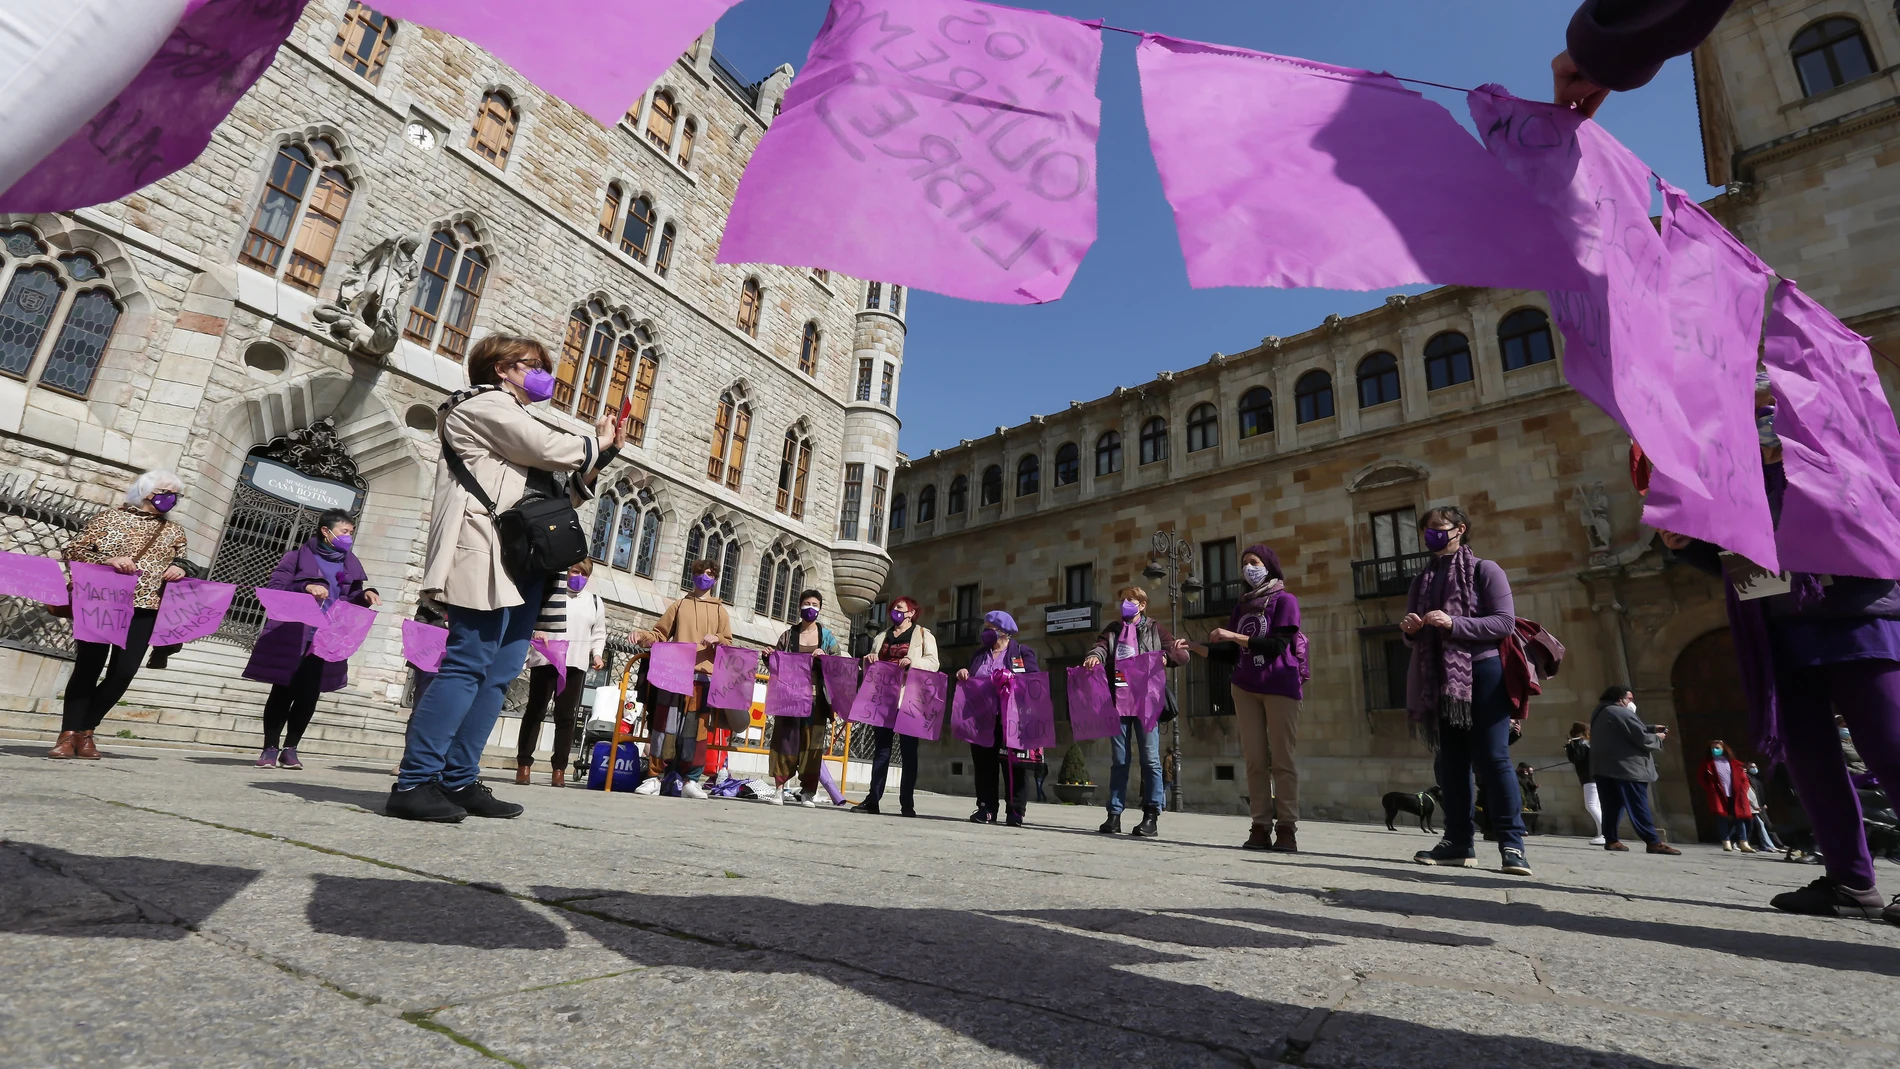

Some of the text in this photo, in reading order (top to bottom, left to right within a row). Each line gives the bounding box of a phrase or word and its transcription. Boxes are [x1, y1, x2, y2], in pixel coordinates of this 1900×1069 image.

[268, 479, 294, 493] CASA
[296, 487, 339, 506] BOTINES
[286, 479, 307, 490] MUSEO
[81, 606, 128, 633] MATA
[163, 602, 212, 626] UNA
[159, 608, 222, 645] MENOS
[719, 654, 745, 673] NO
[864, 671, 897, 686] SOLO
[874, 685, 883, 694] SI
[871, 695, 882, 706] ES
[859, 705, 878, 720] SI
